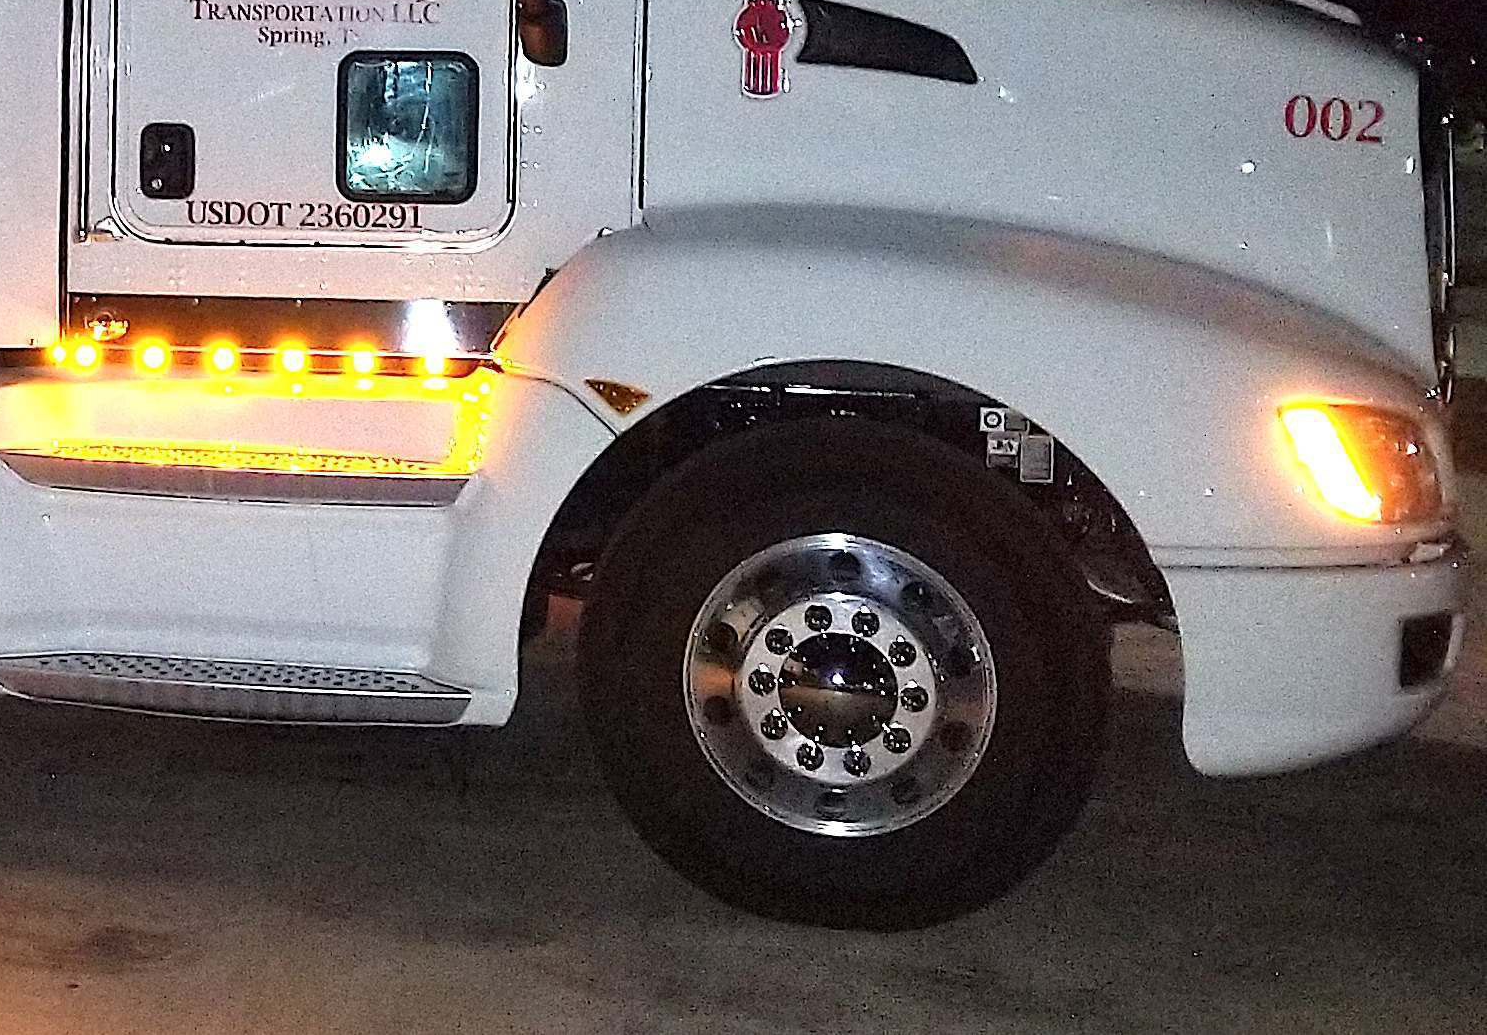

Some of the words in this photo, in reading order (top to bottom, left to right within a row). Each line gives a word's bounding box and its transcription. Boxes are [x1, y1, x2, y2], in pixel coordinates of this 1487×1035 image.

[258, 26, 331, 47] Spring,
[1284, 94, 1386, 142] 002
[185, 200, 292, 225] USDOT
[299, 202, 423, 229] 2360291
